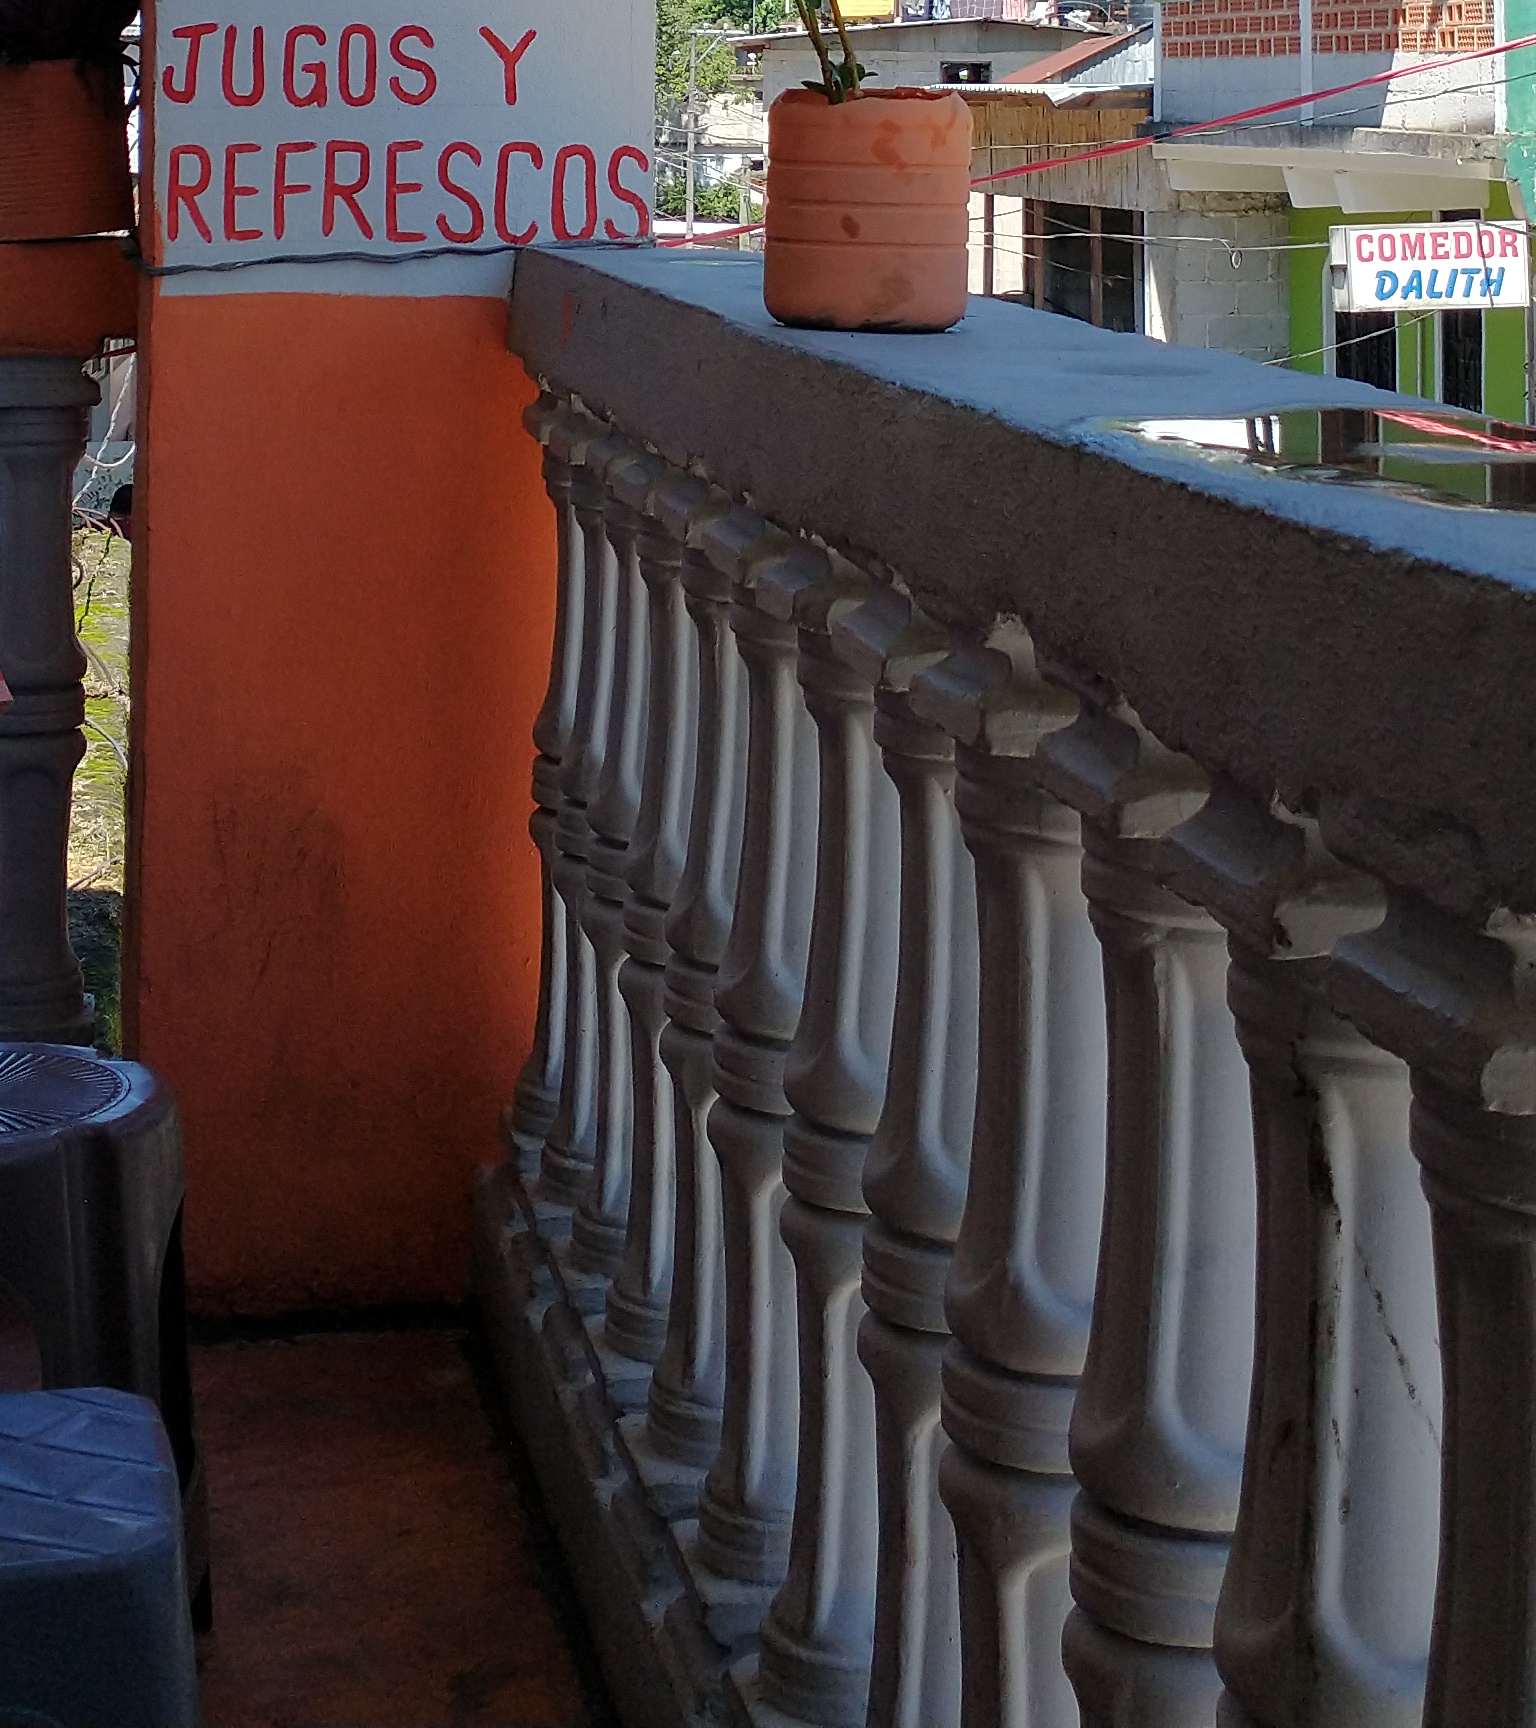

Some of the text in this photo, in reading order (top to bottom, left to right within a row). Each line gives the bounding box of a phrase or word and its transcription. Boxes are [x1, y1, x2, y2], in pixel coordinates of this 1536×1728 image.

[162, 23, 537, 109] JUGOS Y
[167, 140, 650, 246] REFRESCOS
[1355, 230, 1519, 263] COMEDOR
[1374, 266, 1506, 301] DALITH
